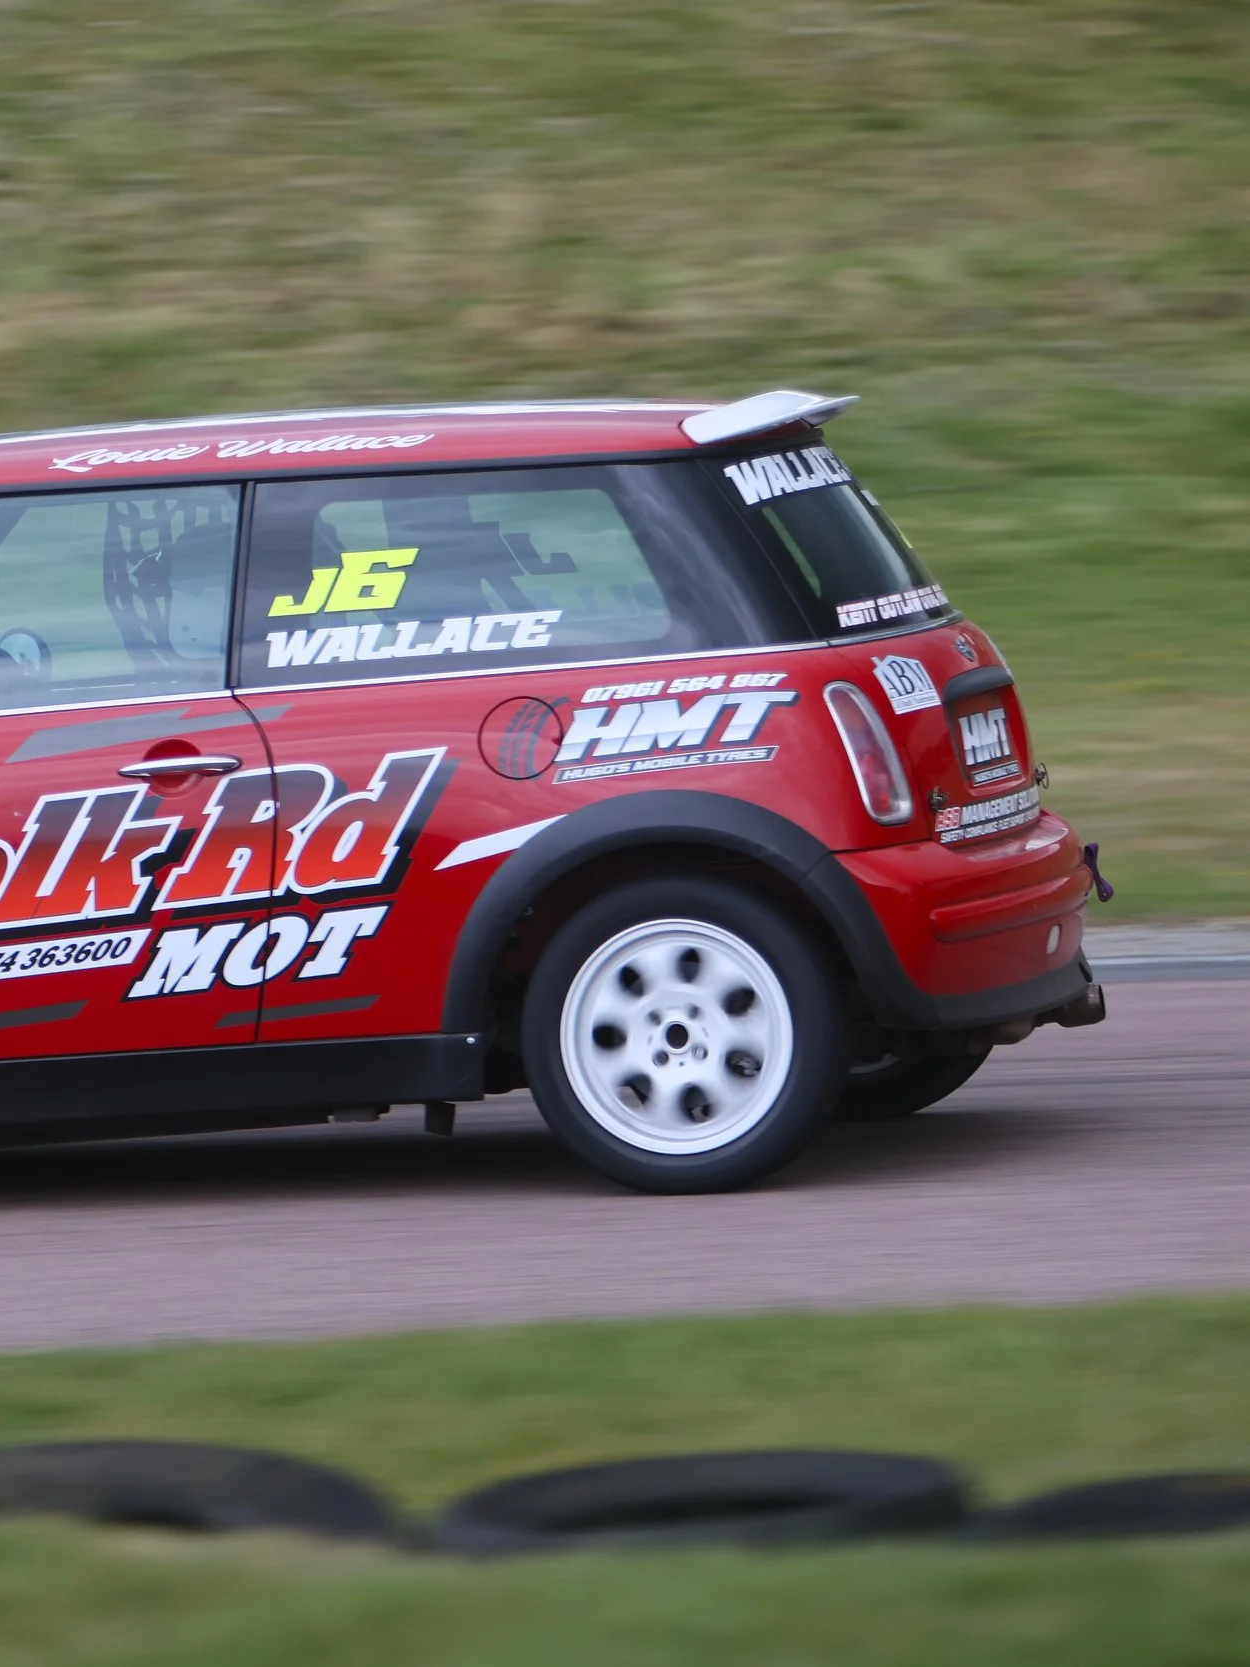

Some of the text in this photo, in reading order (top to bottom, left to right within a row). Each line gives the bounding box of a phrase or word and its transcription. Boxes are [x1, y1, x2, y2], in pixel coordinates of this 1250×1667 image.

[48, 433, 435, 473] Louie Wallace
[267, 547, 420, 617] J6
[266, 610, 562, 668] WALLACE
[667, 675, 727, 693] 564
[553, 691, 799, 763] HMT
[957, 708, 1012, 766] HMT
[150, 746, 448, 911] Rd
[19, 937, 134, 970] 363600
[124, 905, 391, 999] MOT
